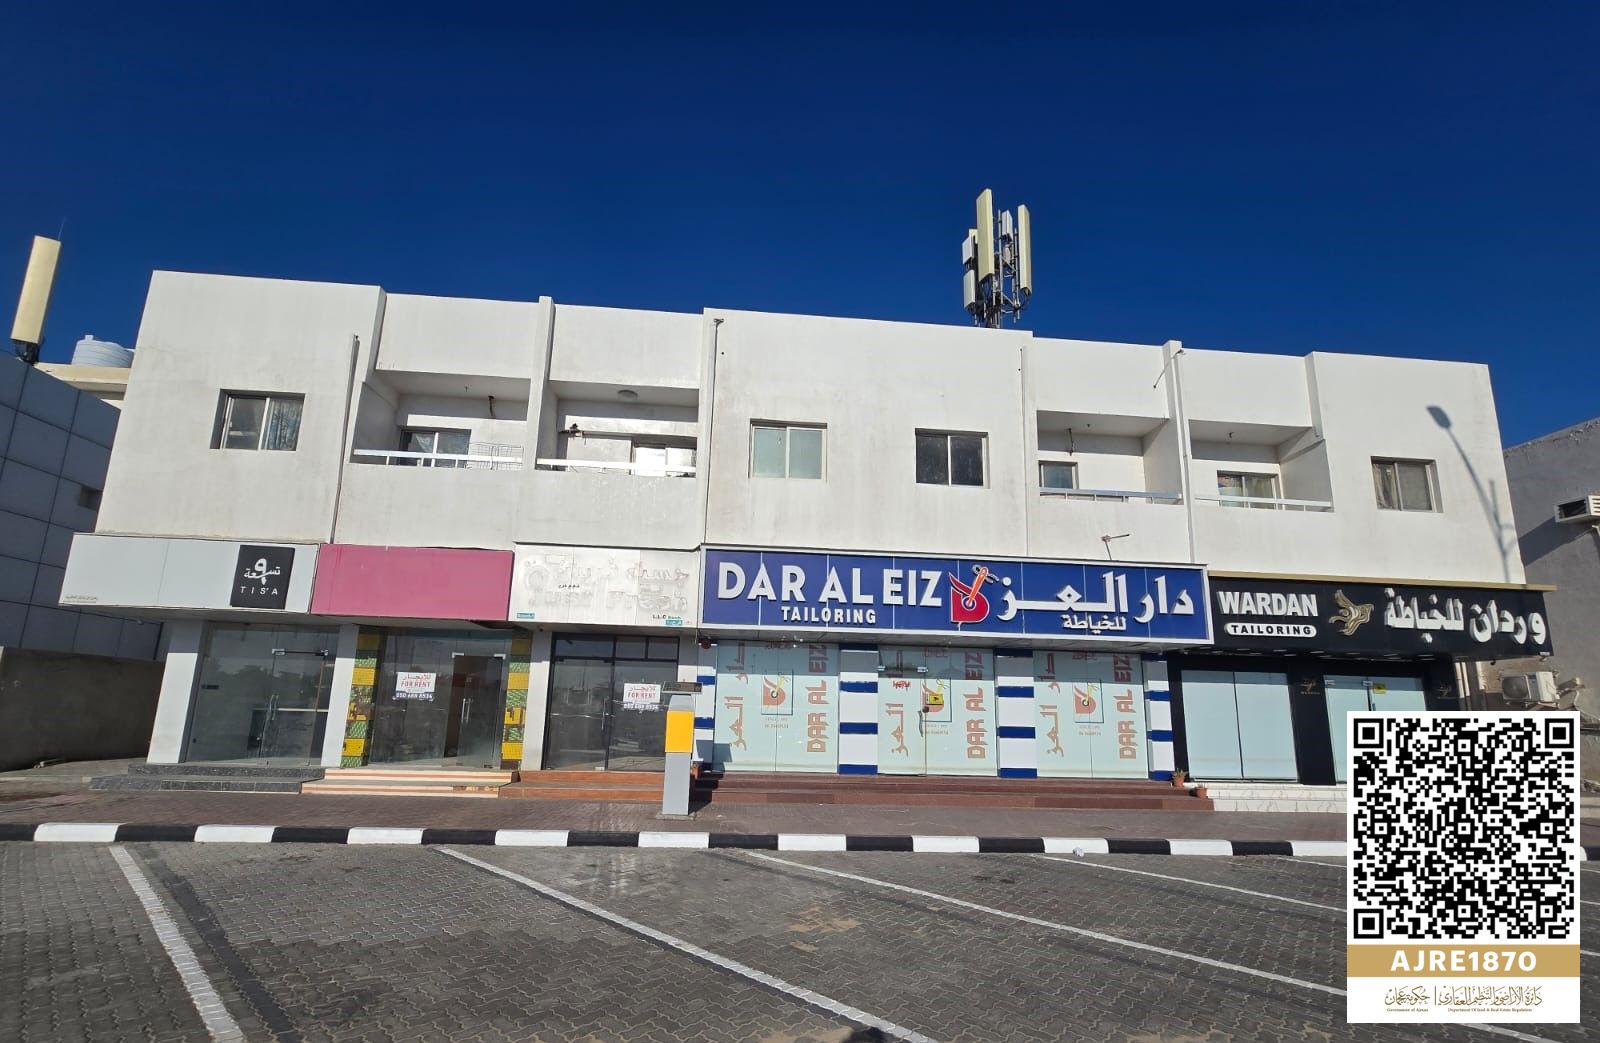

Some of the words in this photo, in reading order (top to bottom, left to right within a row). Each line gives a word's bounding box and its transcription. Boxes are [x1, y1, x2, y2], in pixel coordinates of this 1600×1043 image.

[718, 562, 806, 602] DAR
[818, 566, 874, 604] AL
[883, 568, 942, 606] EIZ
[997, 571, 1128, 621] العز
[1134, 576, 1194, 624] دار
[1217, 591, 1318, 616] WARDAN
[782, 606, 876, 624] TAILORING
[1061, 614, 1126, 634] للخياطة
[1231, 624, 1312, 635] TAILORING
[1384, 588, 1464, 644] للخياطة
[1470, 600, 1546, 644] وردان
[808, 644, 829, 672] EIZ
[965, 650, 984, 680] EIZ
[1112, 654, 1133, 682] EIZ
[805, 680, 830, 704] AL
[963, 687, 986, 712] AL
[1113, 688, 1136, 714] AL
[806, 712, 830, 752] DAR
[966, 719, 988, 758] DAR
[1118, 720, 1138, 760] DAR
